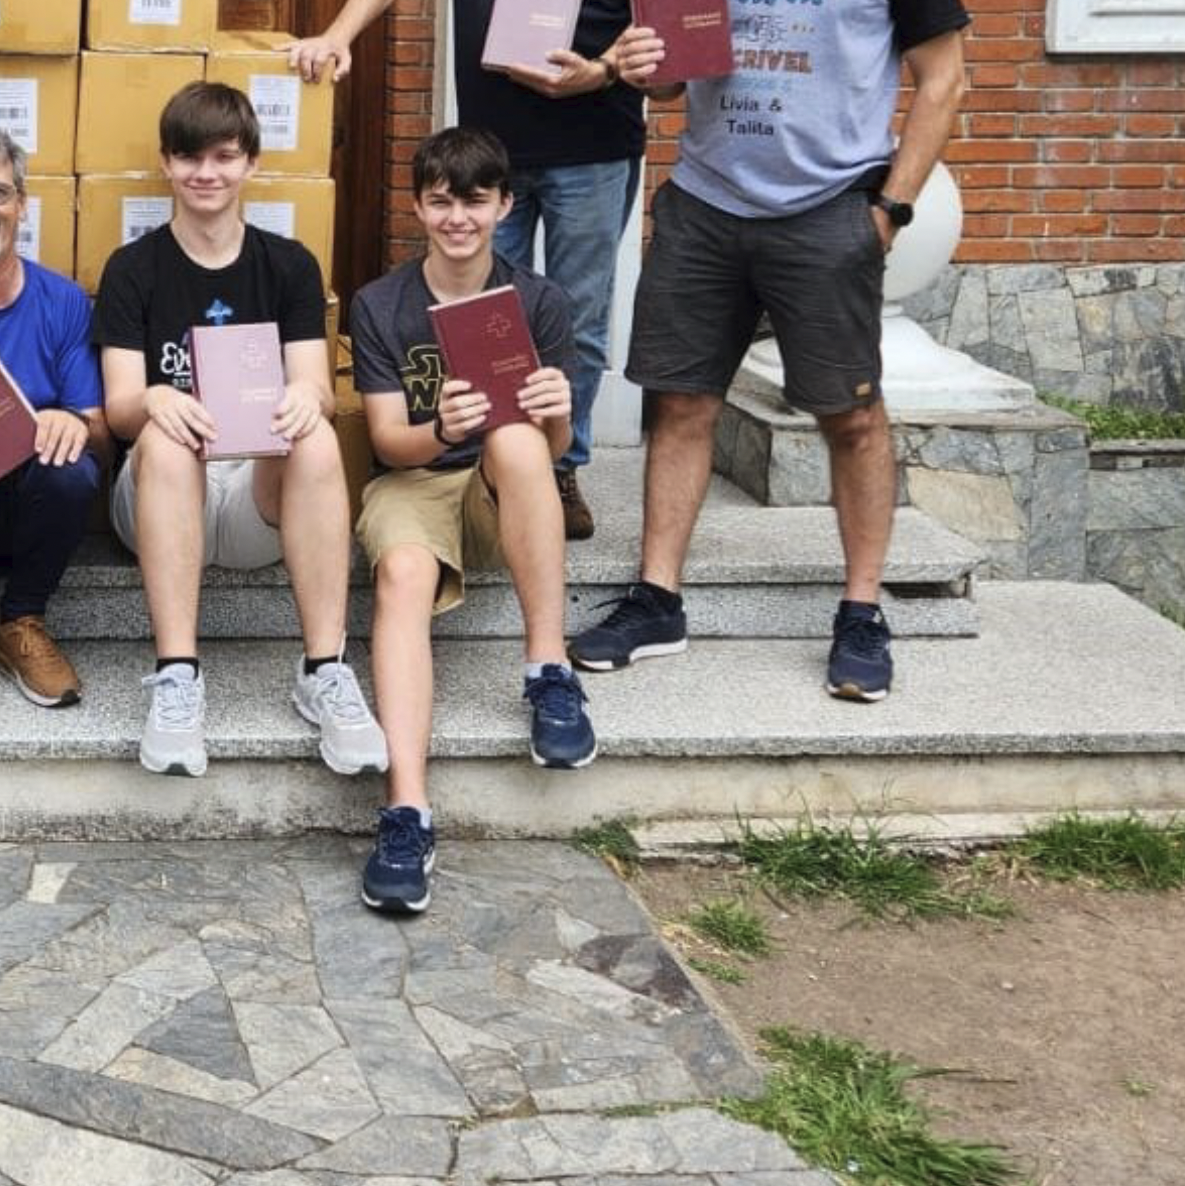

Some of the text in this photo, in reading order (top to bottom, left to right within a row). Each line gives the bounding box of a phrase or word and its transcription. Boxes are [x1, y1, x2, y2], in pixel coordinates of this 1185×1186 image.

[768, 97, 782, 112] &
[726, 119, 774, 135] Talita
[160, 342, 191, 374] Ev
